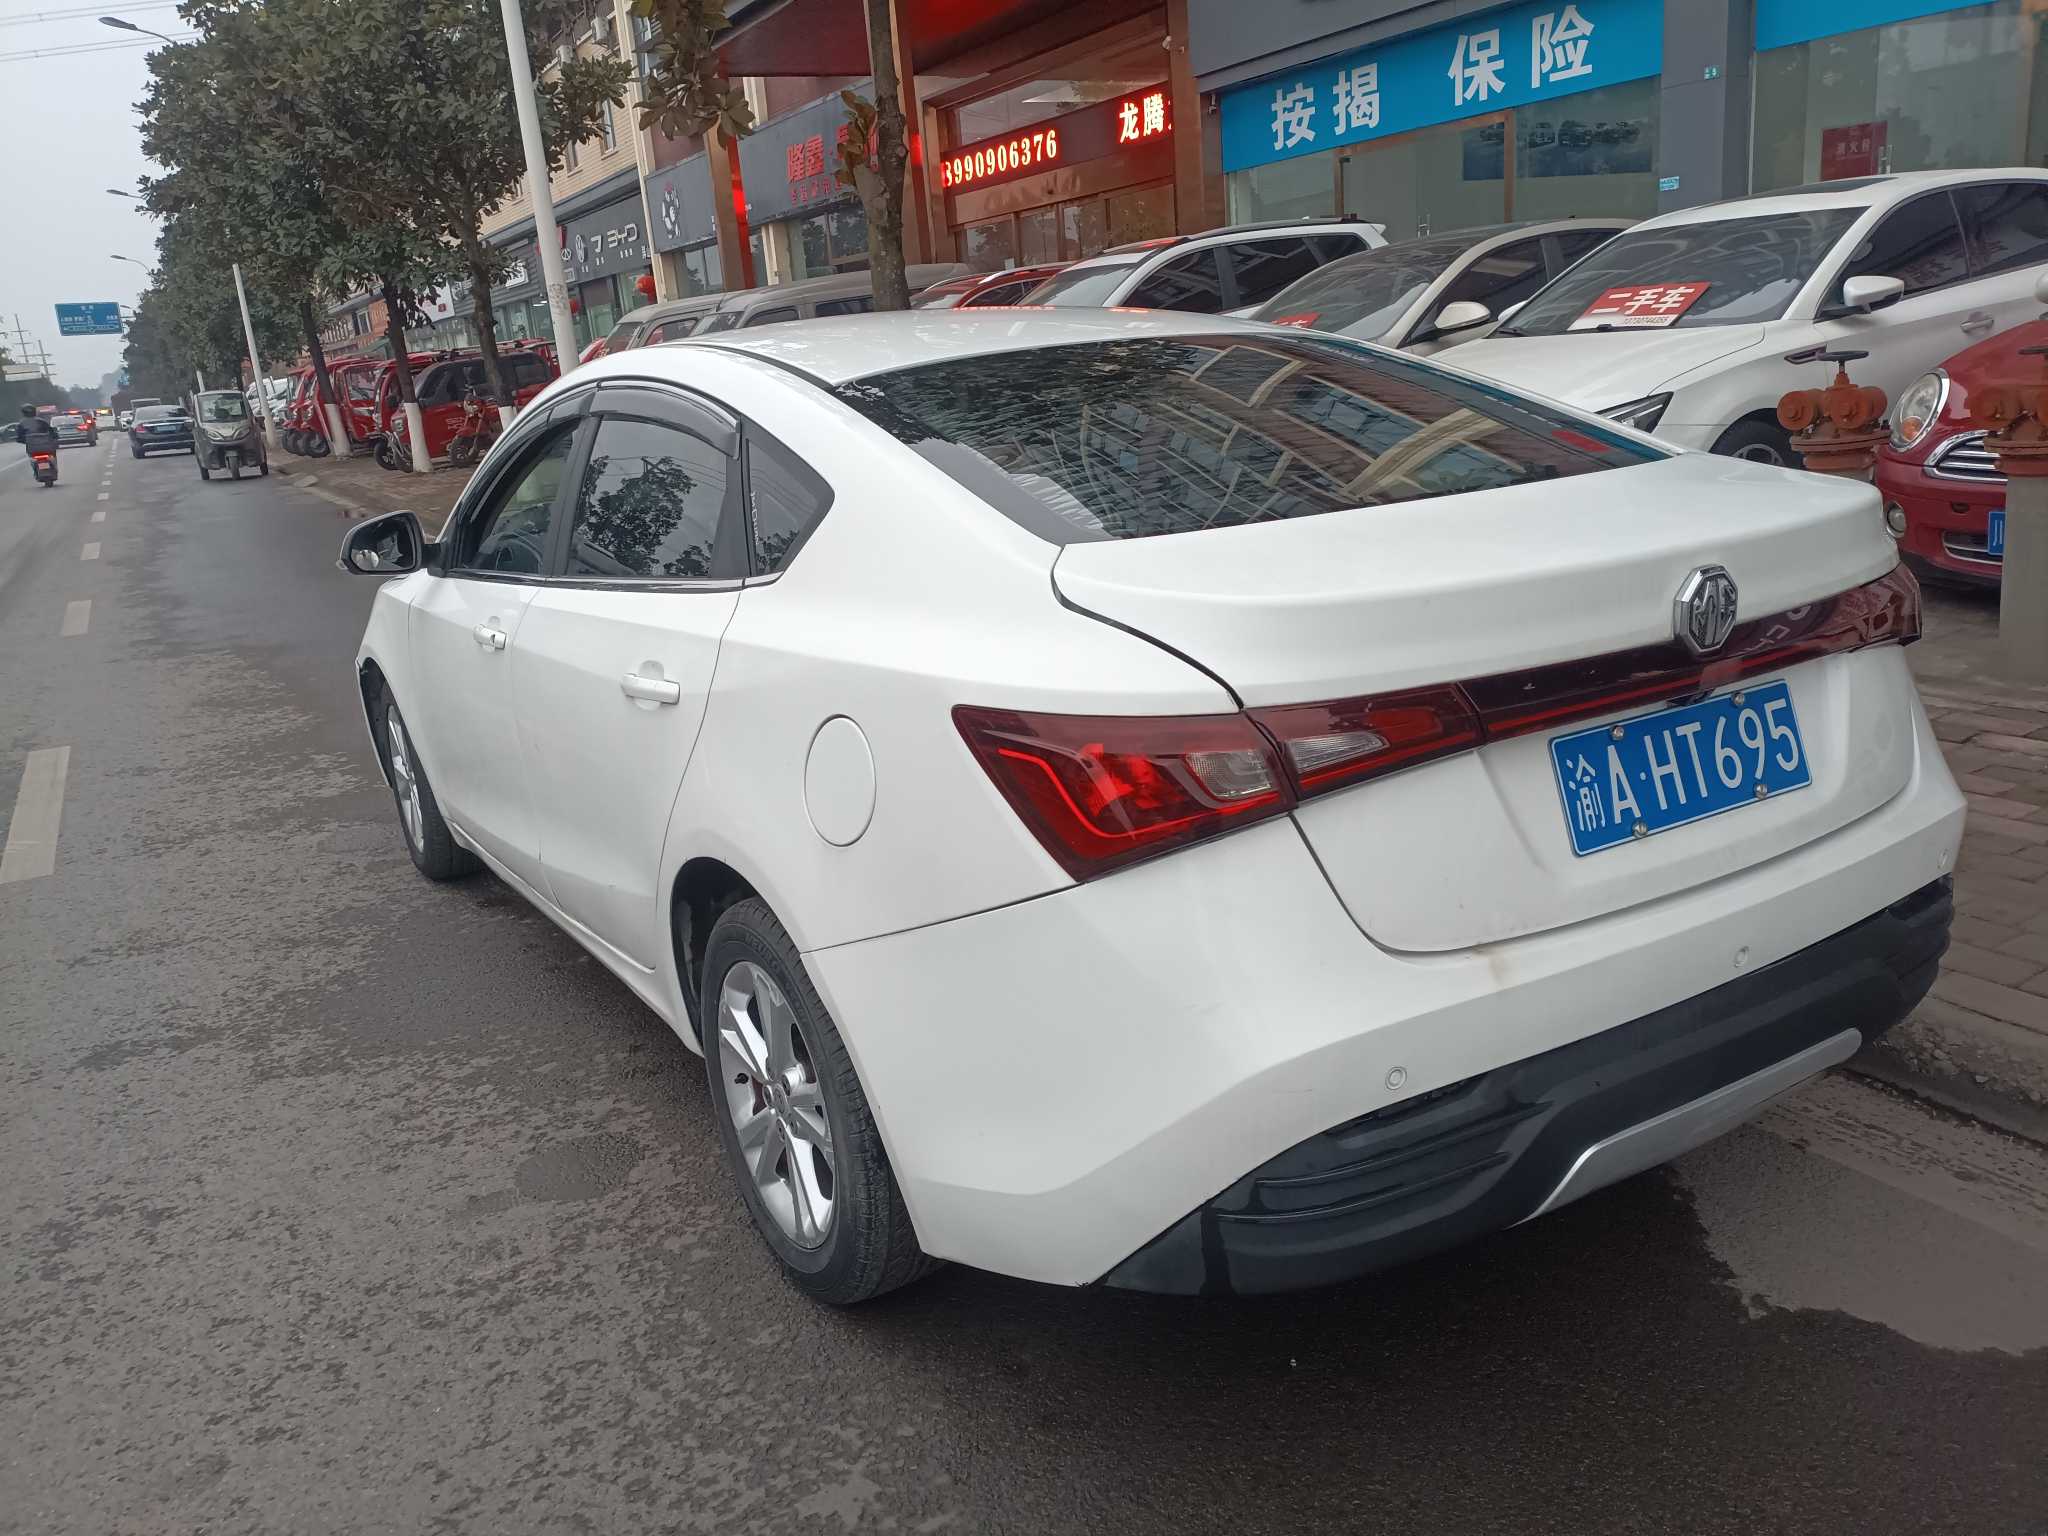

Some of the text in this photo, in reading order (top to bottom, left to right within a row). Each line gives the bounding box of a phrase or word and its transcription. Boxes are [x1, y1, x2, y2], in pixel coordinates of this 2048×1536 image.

[1271, 5, 1594, 150] 按揭 保险
[1119, 93, 1172, 143] 龙腾
[607, 223, 638, 248] BYD
[1590, 286, 1696, 315] 二手车
